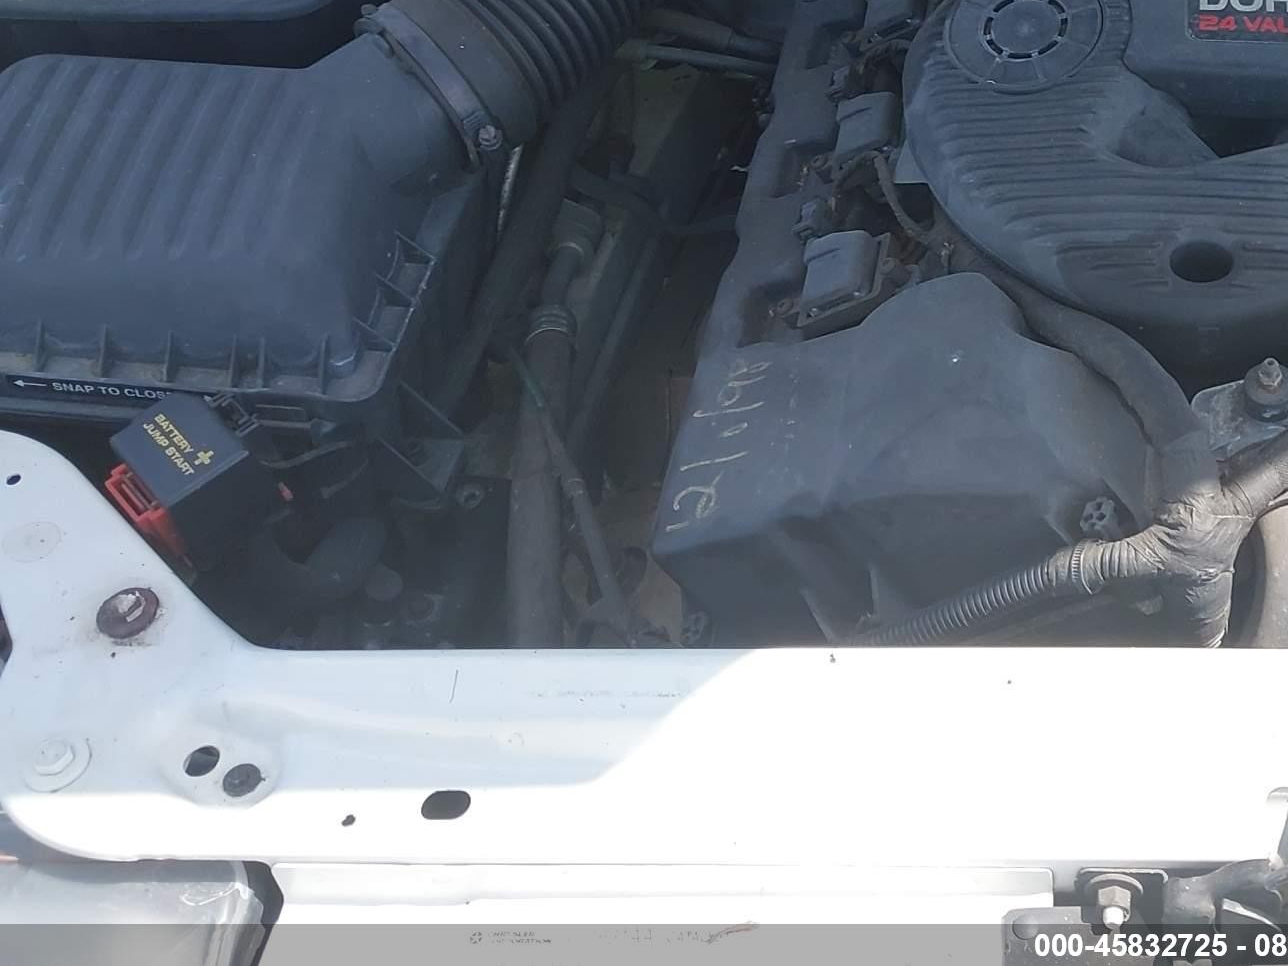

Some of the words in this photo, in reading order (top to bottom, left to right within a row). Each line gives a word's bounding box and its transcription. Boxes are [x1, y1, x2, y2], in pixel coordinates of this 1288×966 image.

[1197, 15, 1237, 32] 24
[52, 382, 94, 394] SNAP
[100, 386, 119, 396] TO
[124, 388, 172, 400] CLOS
[154, 413, 194, 453] BATTERY
[143, 423, 169, 446] JUMP
[165, 447, 195, 474] START
